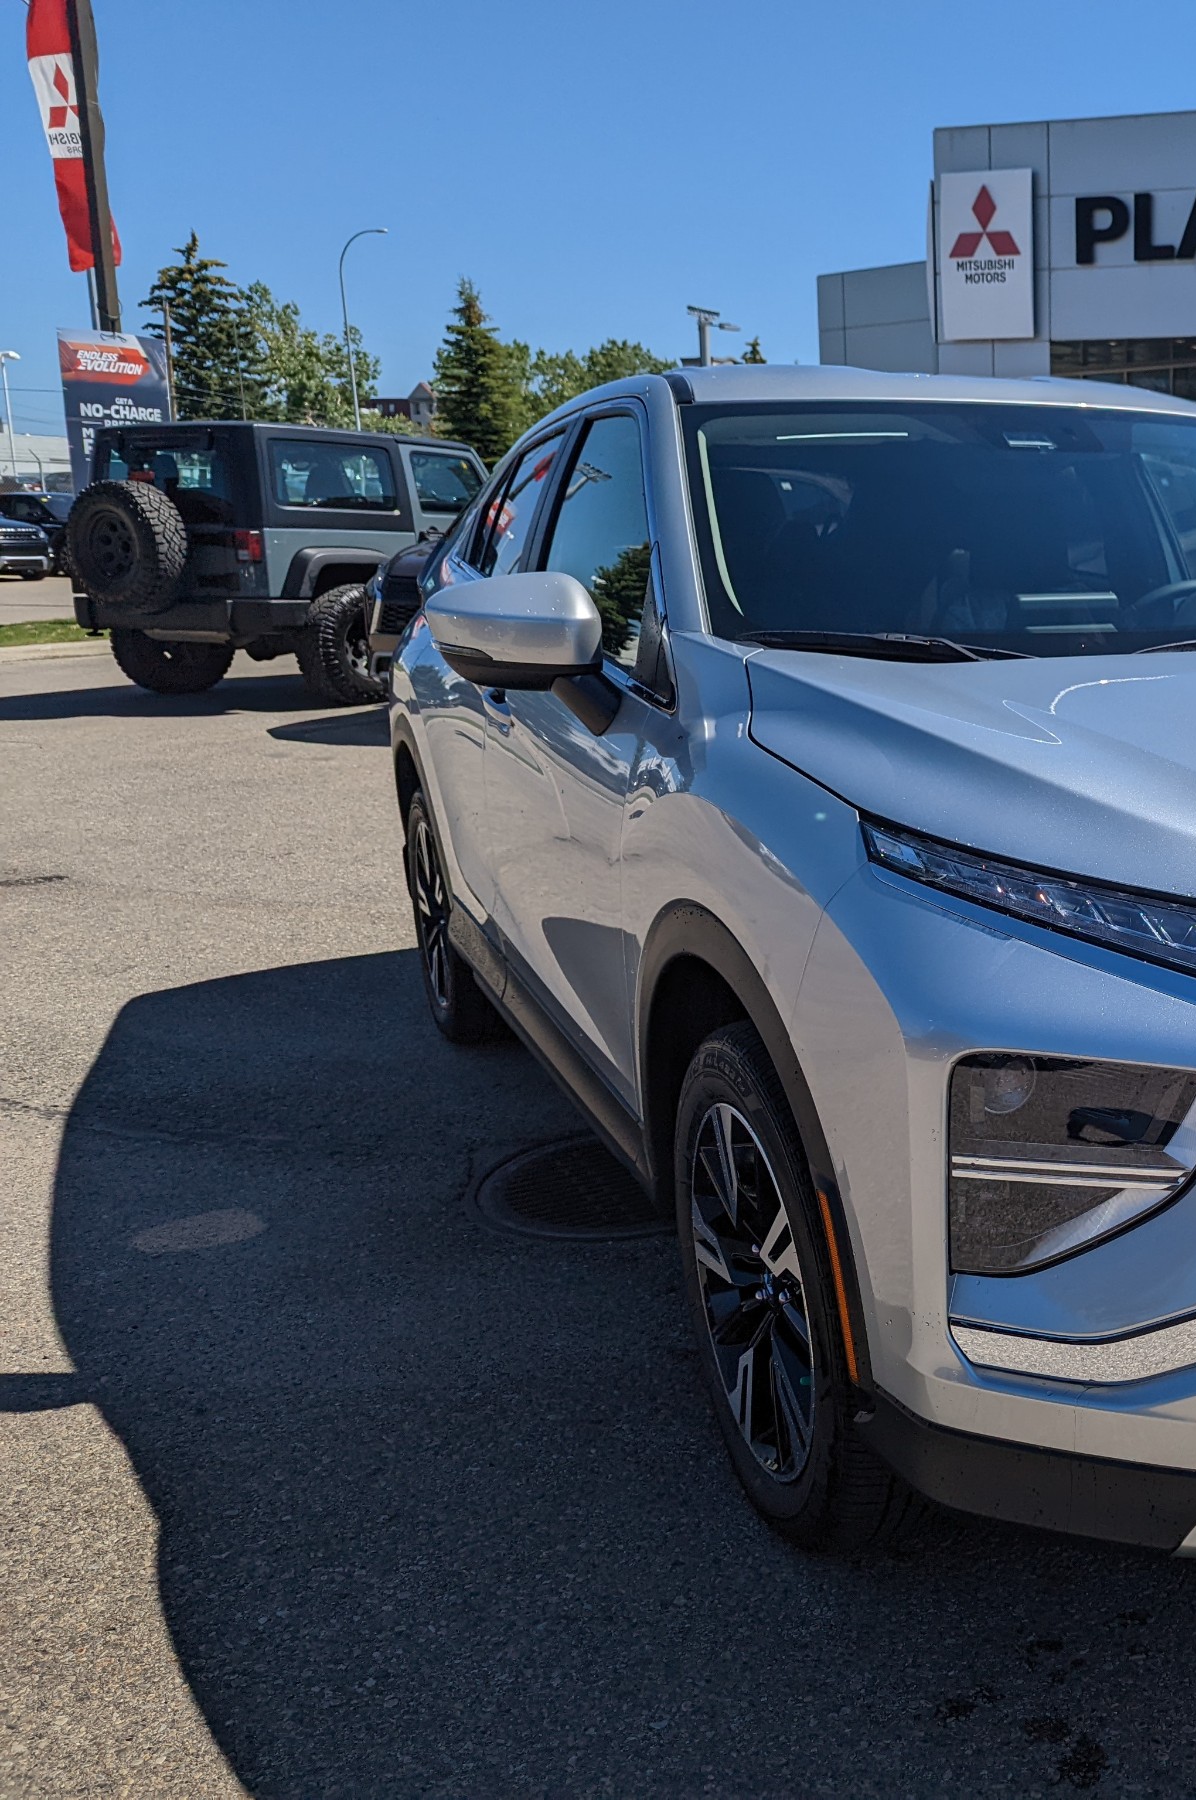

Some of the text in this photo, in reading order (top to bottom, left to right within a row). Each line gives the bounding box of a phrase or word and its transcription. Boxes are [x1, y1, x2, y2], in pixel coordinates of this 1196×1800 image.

[956, 259, 1014, 271] MITSUBISHI
[965, 272, 1006, 284] MOTORS
[77, 350, 119, 361] ENDLESS
[77, 360, 143, 375] EVOLUTION
[115, 397, 134, 406] GET A
[80, 403, 162, 422] NO-CHARGE
